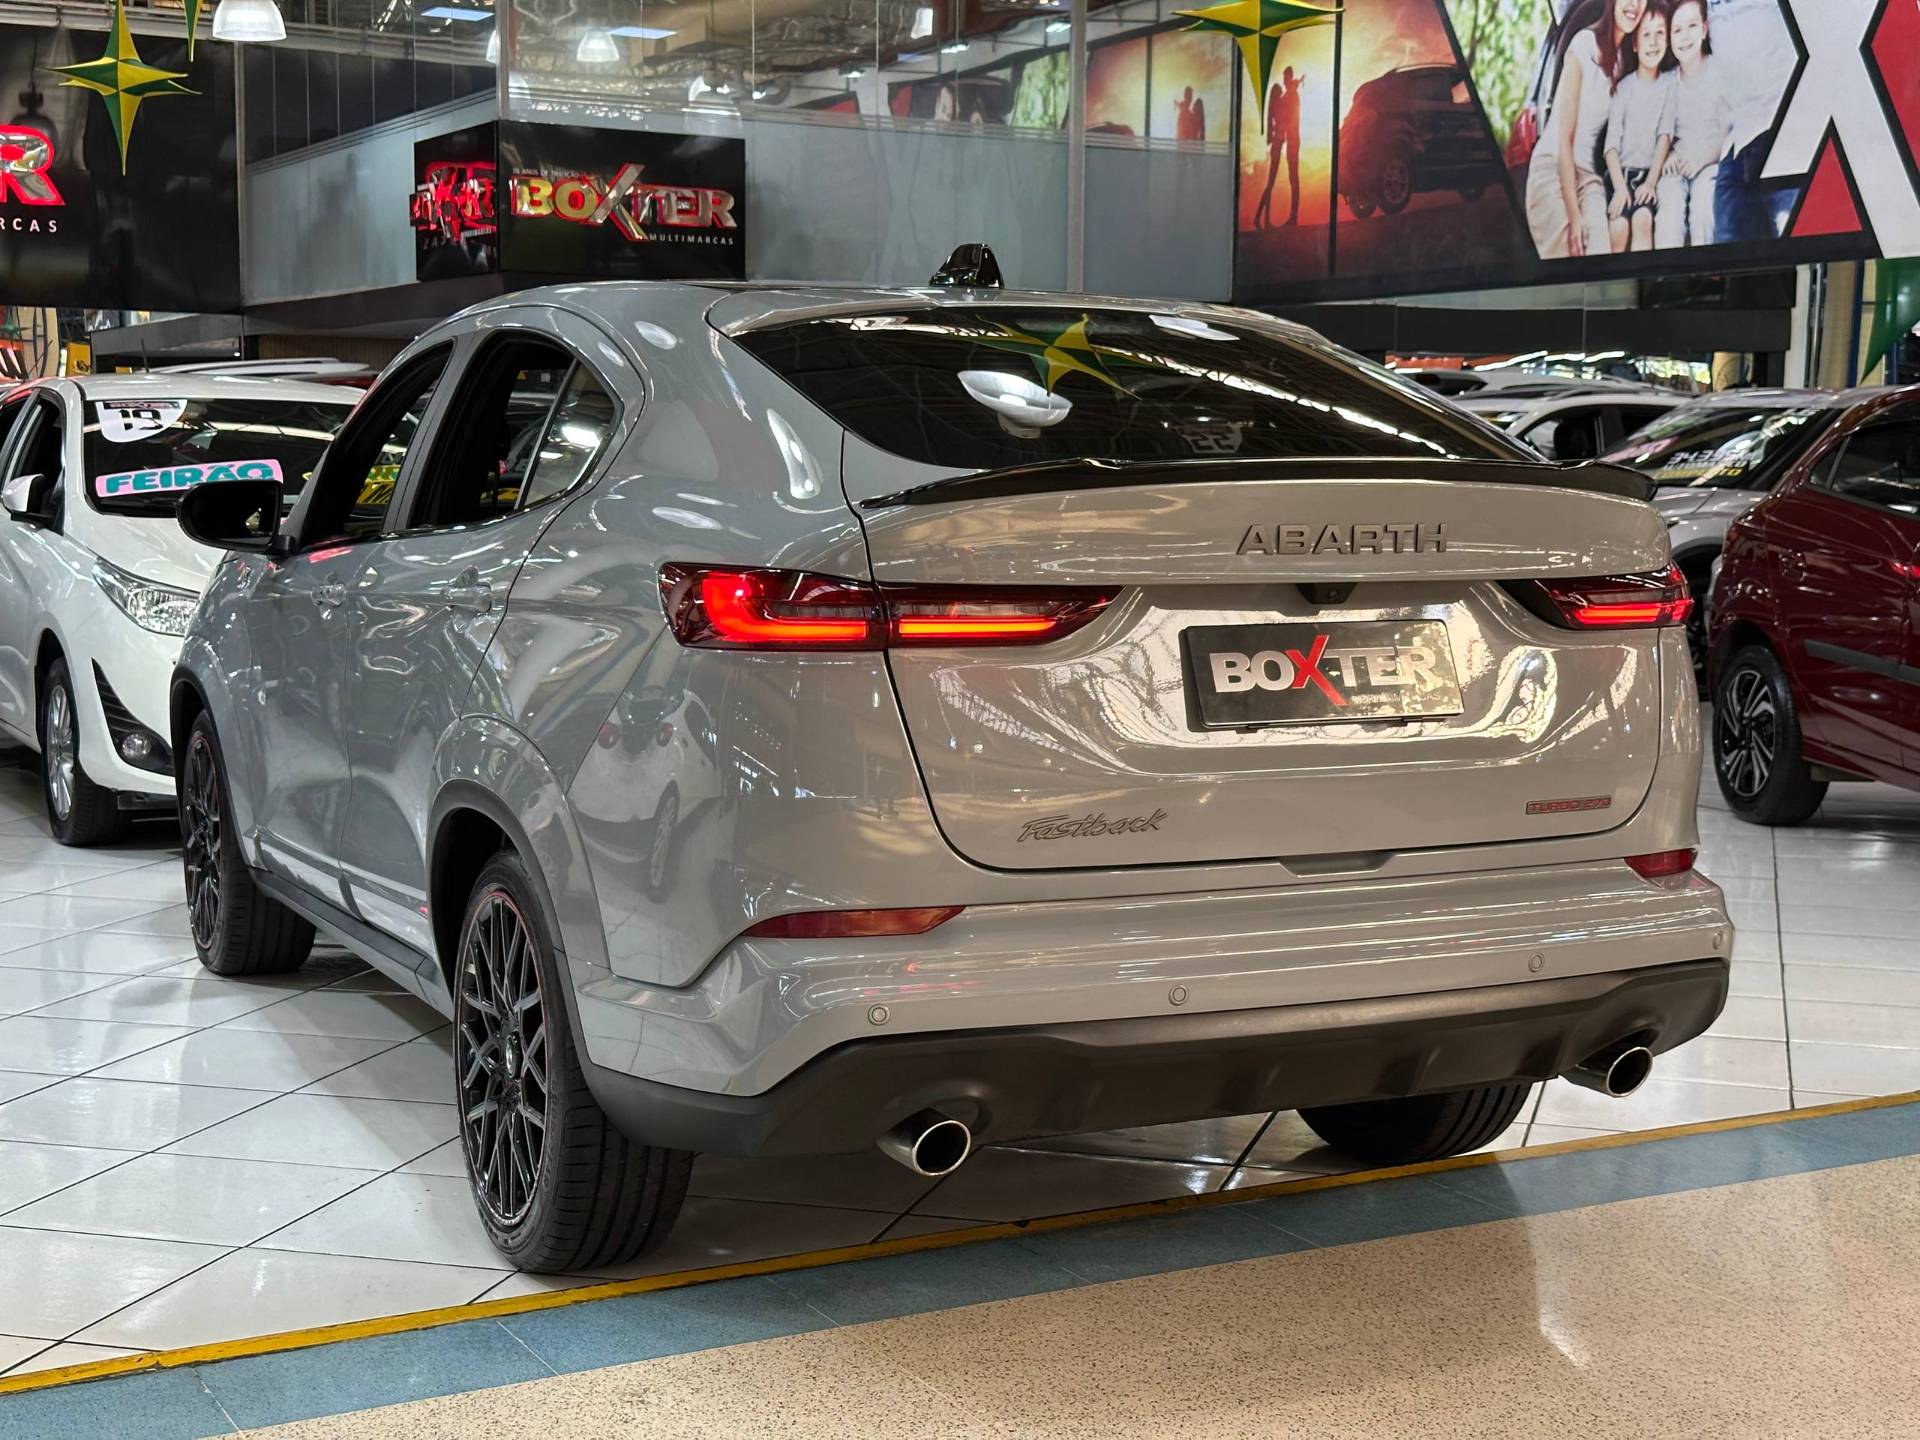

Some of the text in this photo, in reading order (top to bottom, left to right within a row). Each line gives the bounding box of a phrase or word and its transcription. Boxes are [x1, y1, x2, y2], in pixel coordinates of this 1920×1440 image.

[510, 163, 737, 241] BOXTER
[650, 233, 734, 245] MULTIMARCAS
[106, 462, 274, 494] FEIRÃO
[1236, 524, 1448, 555] ABARTH
[1209, 634, 1443, 706] BOXTER
[1017, 808, 1168, 842] Fastback
